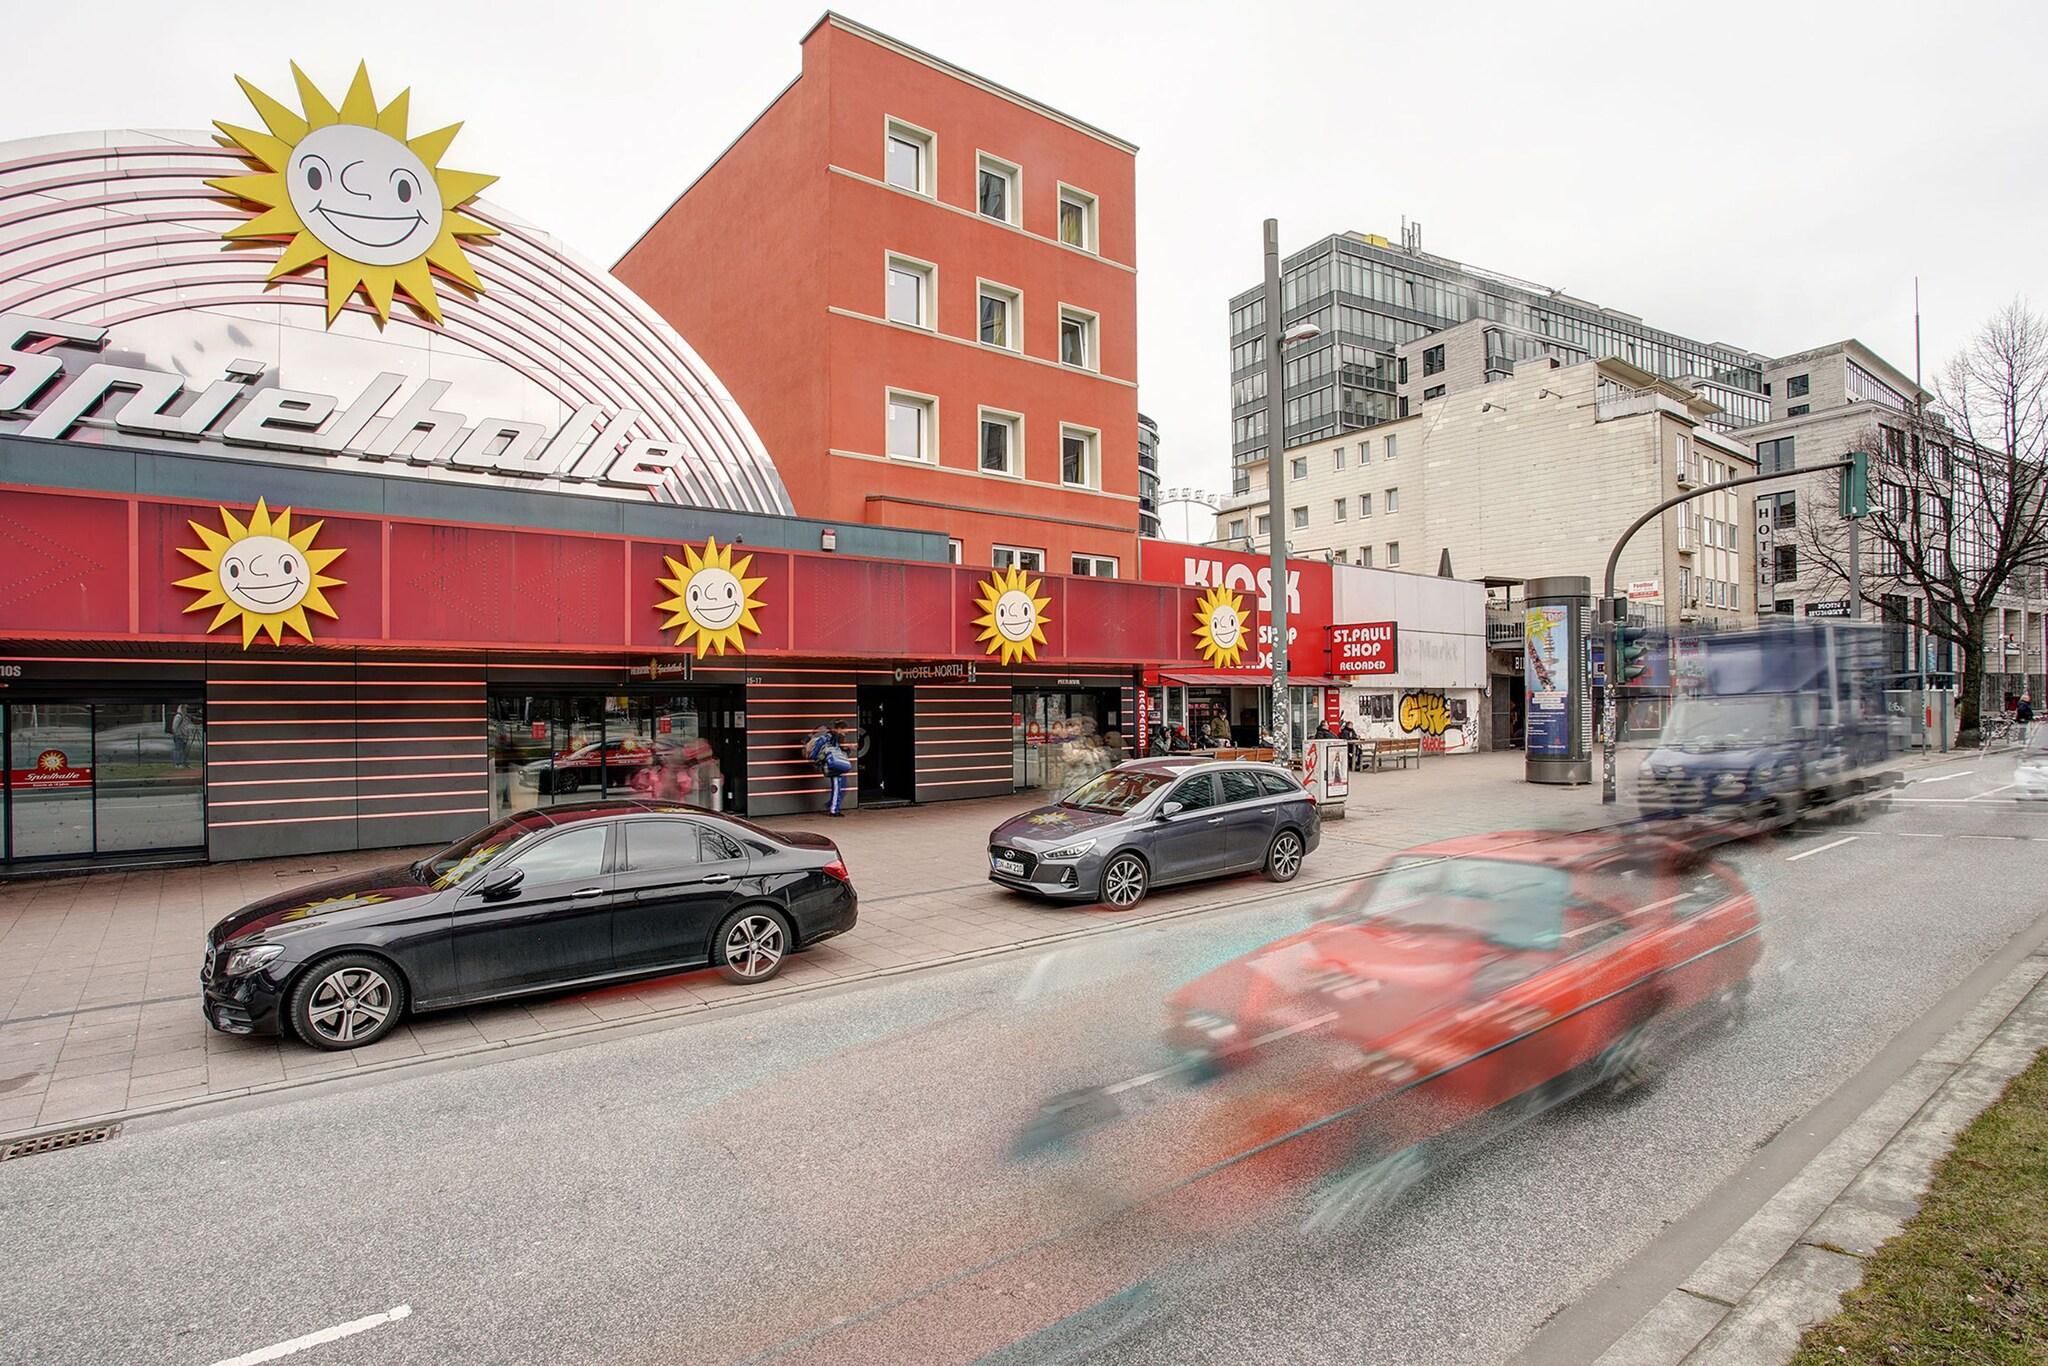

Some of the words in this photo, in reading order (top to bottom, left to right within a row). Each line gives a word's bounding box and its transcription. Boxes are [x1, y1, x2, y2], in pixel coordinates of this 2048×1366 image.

[0, 313, 688, 487] Spielhalle
[1758, 508, 1770, 585] HOTEL
[1184, 558, 1300, 614] KIOSK
[1258, 626, 1298, 645] SP
[1333, 627, 1391, 643] ST.PAULI
[1343, 642, 1382, 658] SHOP
[905, 667, 932, 679] HOTEL
[934, 664, 963, 677] NORTH
[1340, 661, 1386, 671] RELOADED
